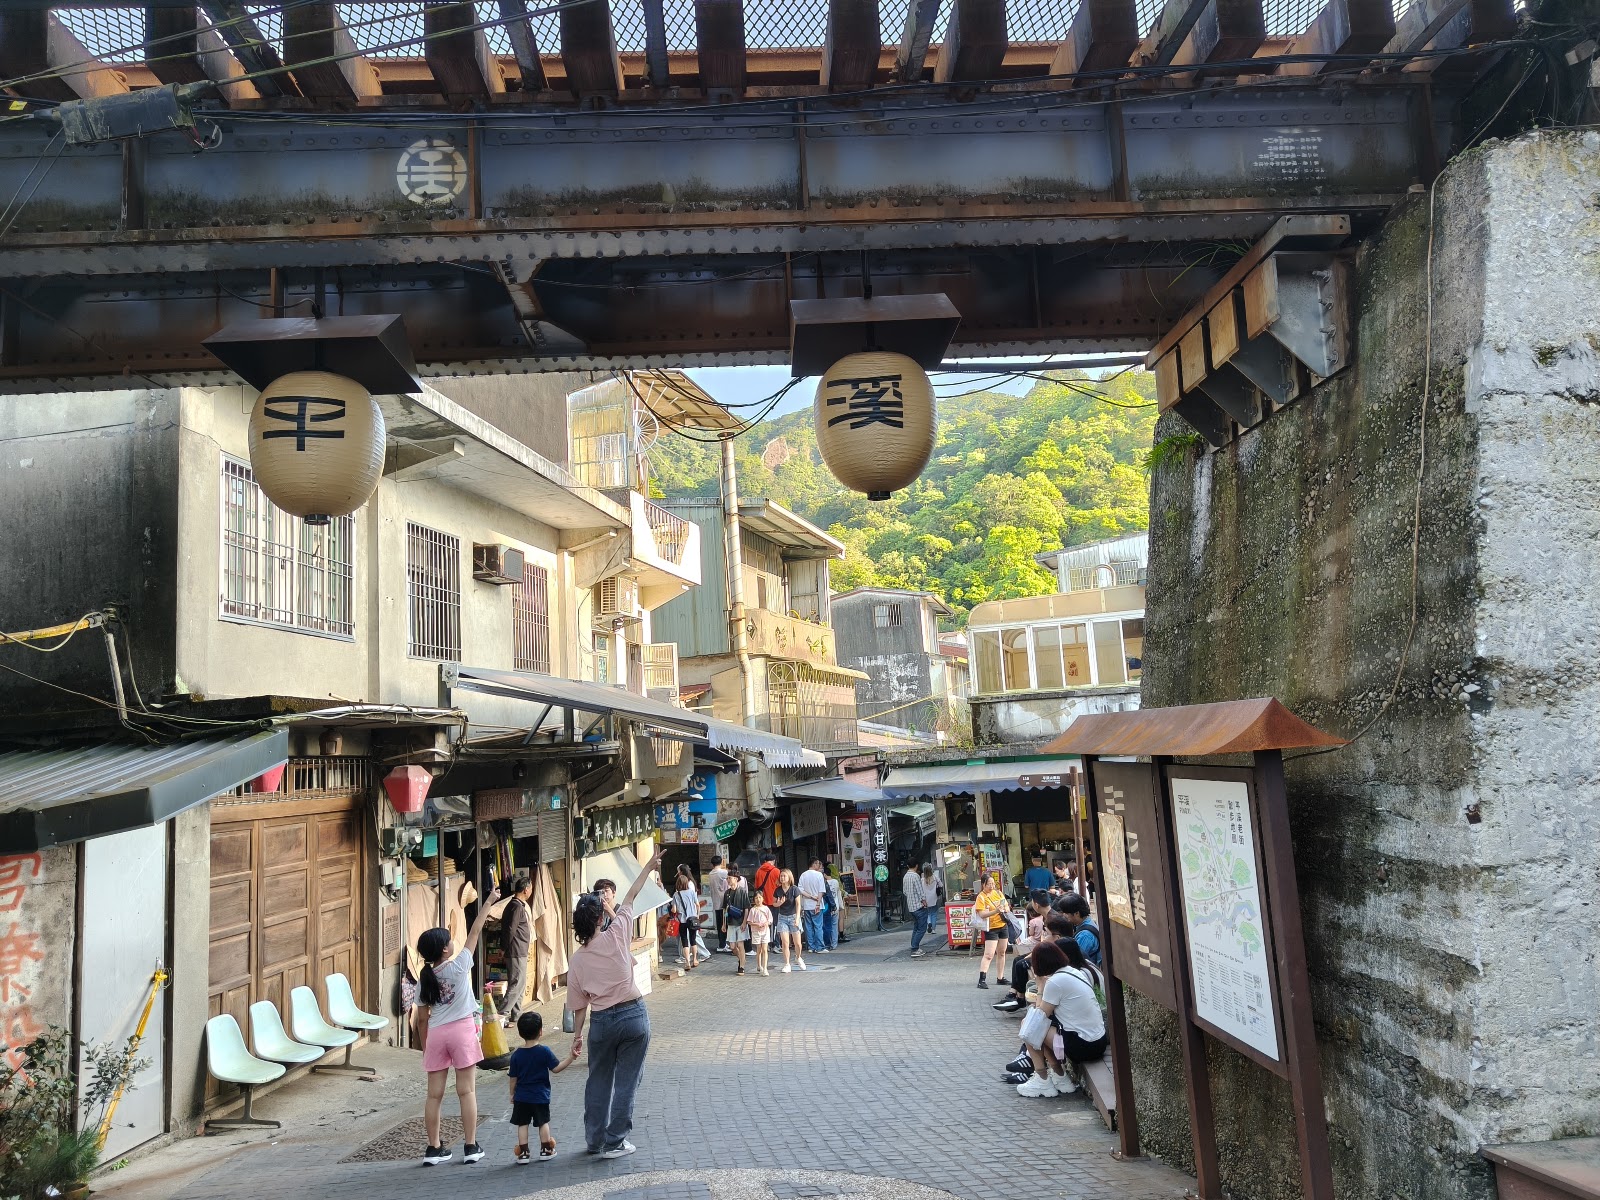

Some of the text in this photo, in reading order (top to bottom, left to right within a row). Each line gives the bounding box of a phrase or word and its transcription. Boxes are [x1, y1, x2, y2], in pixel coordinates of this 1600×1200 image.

[263, 396, 346, 451] 平
[826, 374, 904, 430] 溪
[689, 775, 706, 791] 心
